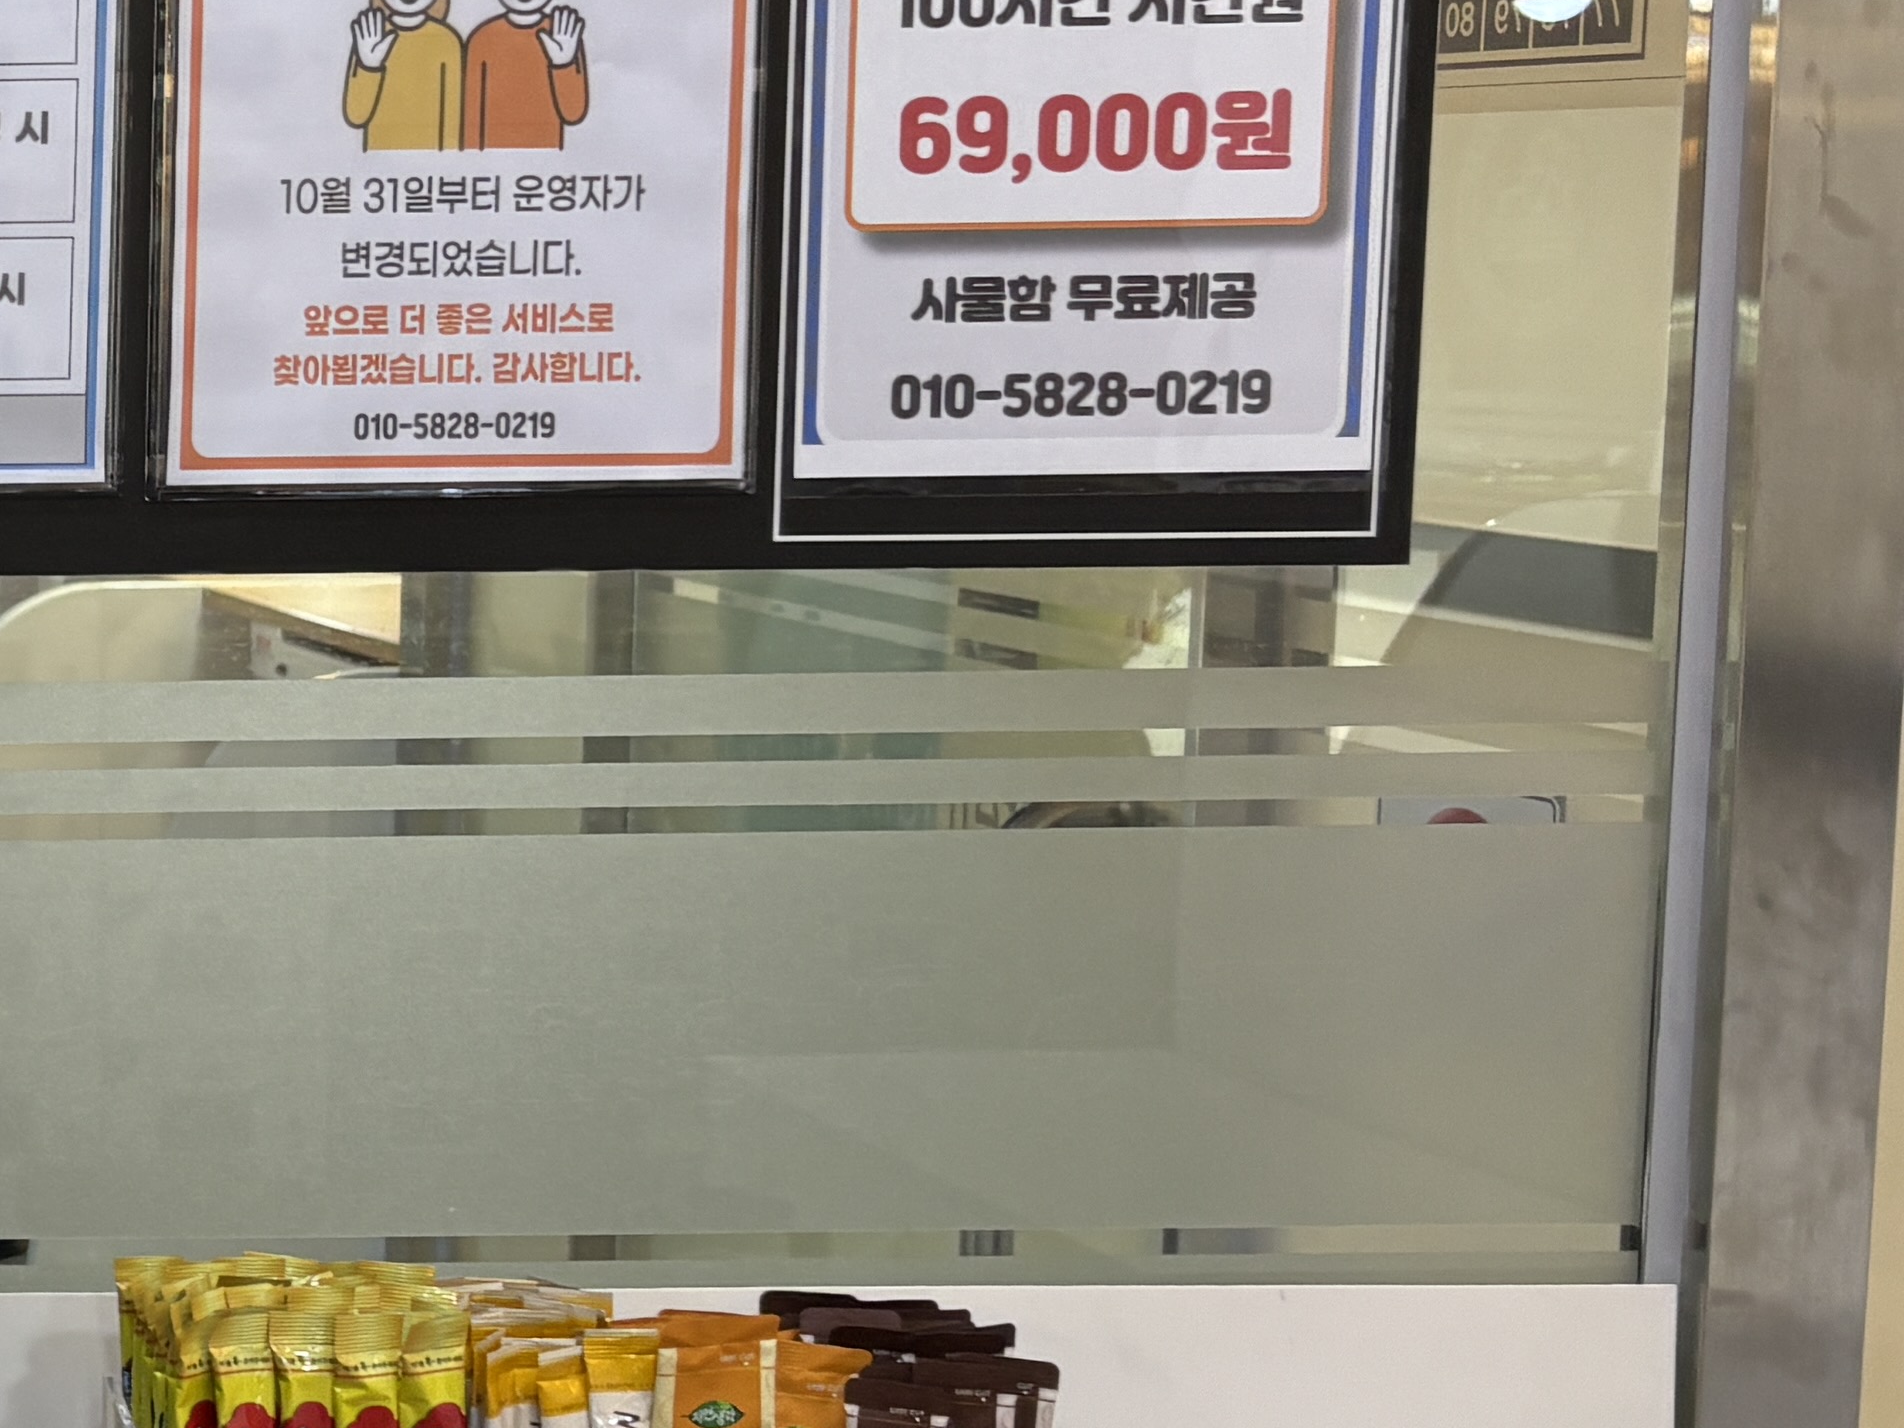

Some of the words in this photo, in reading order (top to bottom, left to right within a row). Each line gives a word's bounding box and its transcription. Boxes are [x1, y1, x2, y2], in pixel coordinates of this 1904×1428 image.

[14, 111, 50, 145] 시
[899, 88, 1294, 184] 69,000원
[281, 178, 353, 214] 10월
[363, 175, 501, 214] 31일부터
[512, 174, 646, 212] 운영자가
[341, 240, 583, 278] 변경되었습니다.
[910, 275, 1055, 323] 사물함
[1067, 273, 1258, 321] 무료제공
[304, 304, 389, 337] 앞으로
[400, 304, 425, 335] 더
[436, 303, 492, 335] 좋은
[502, 302, 614, 334] 서비스로
[274, 353, 483, 386] 찾아뵙겠습니다.
[494, 351, 641, 384] 감사합니다.
[891, 369, 1272, 420] 010-5828-0219
[353, 412, 555, 441] 010-5828-0219
